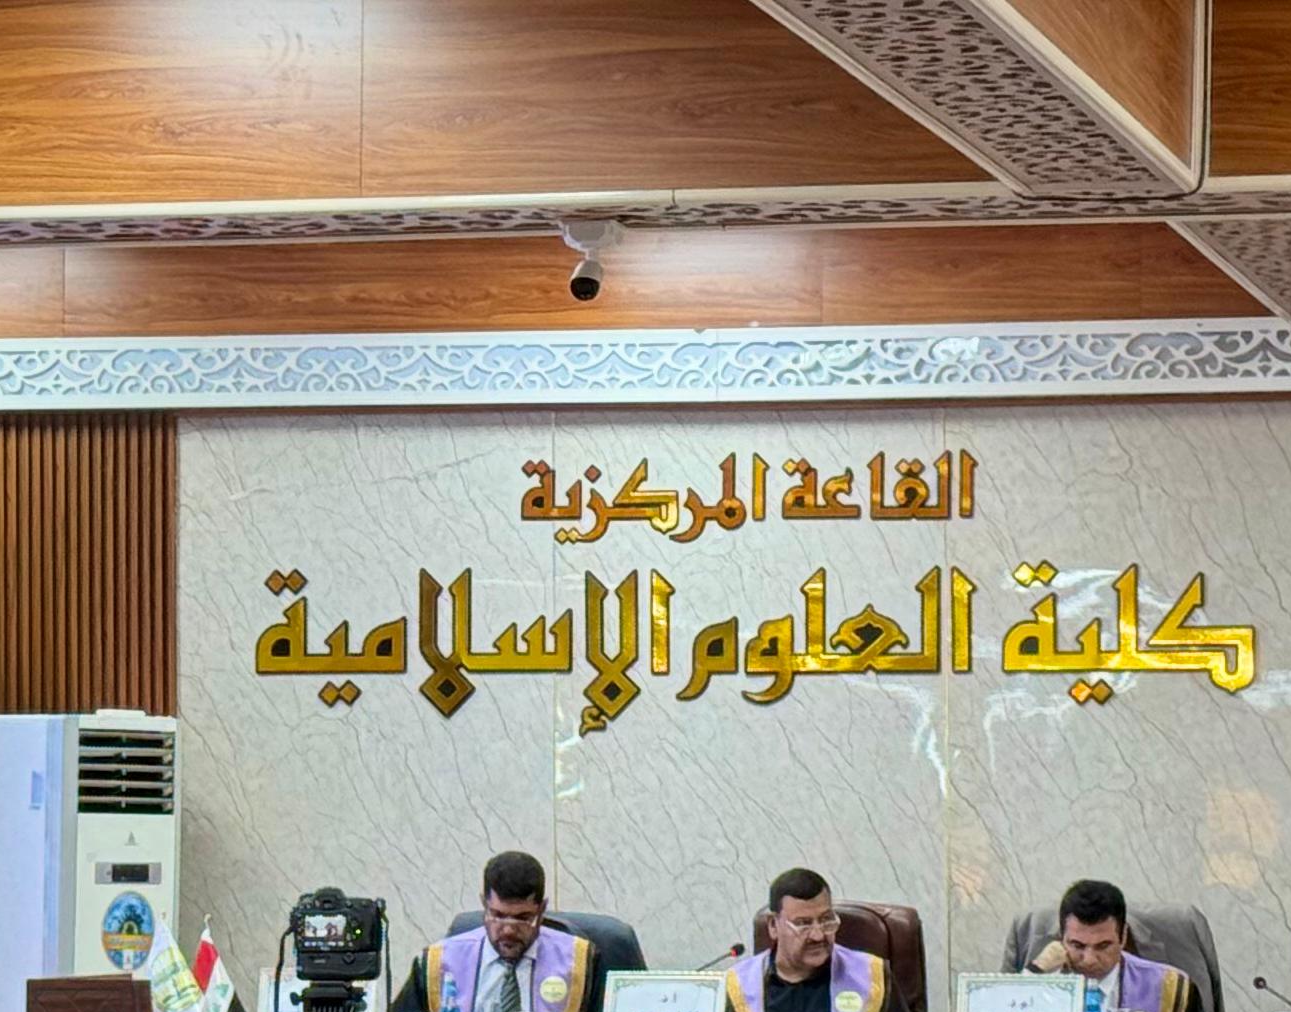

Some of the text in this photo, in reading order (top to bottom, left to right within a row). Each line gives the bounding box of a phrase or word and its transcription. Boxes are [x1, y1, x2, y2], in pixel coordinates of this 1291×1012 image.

[521, 449, 978, 545] القاعة المركزية
[254, 561, 1257, 736] كلية العلوم الإسلامية
